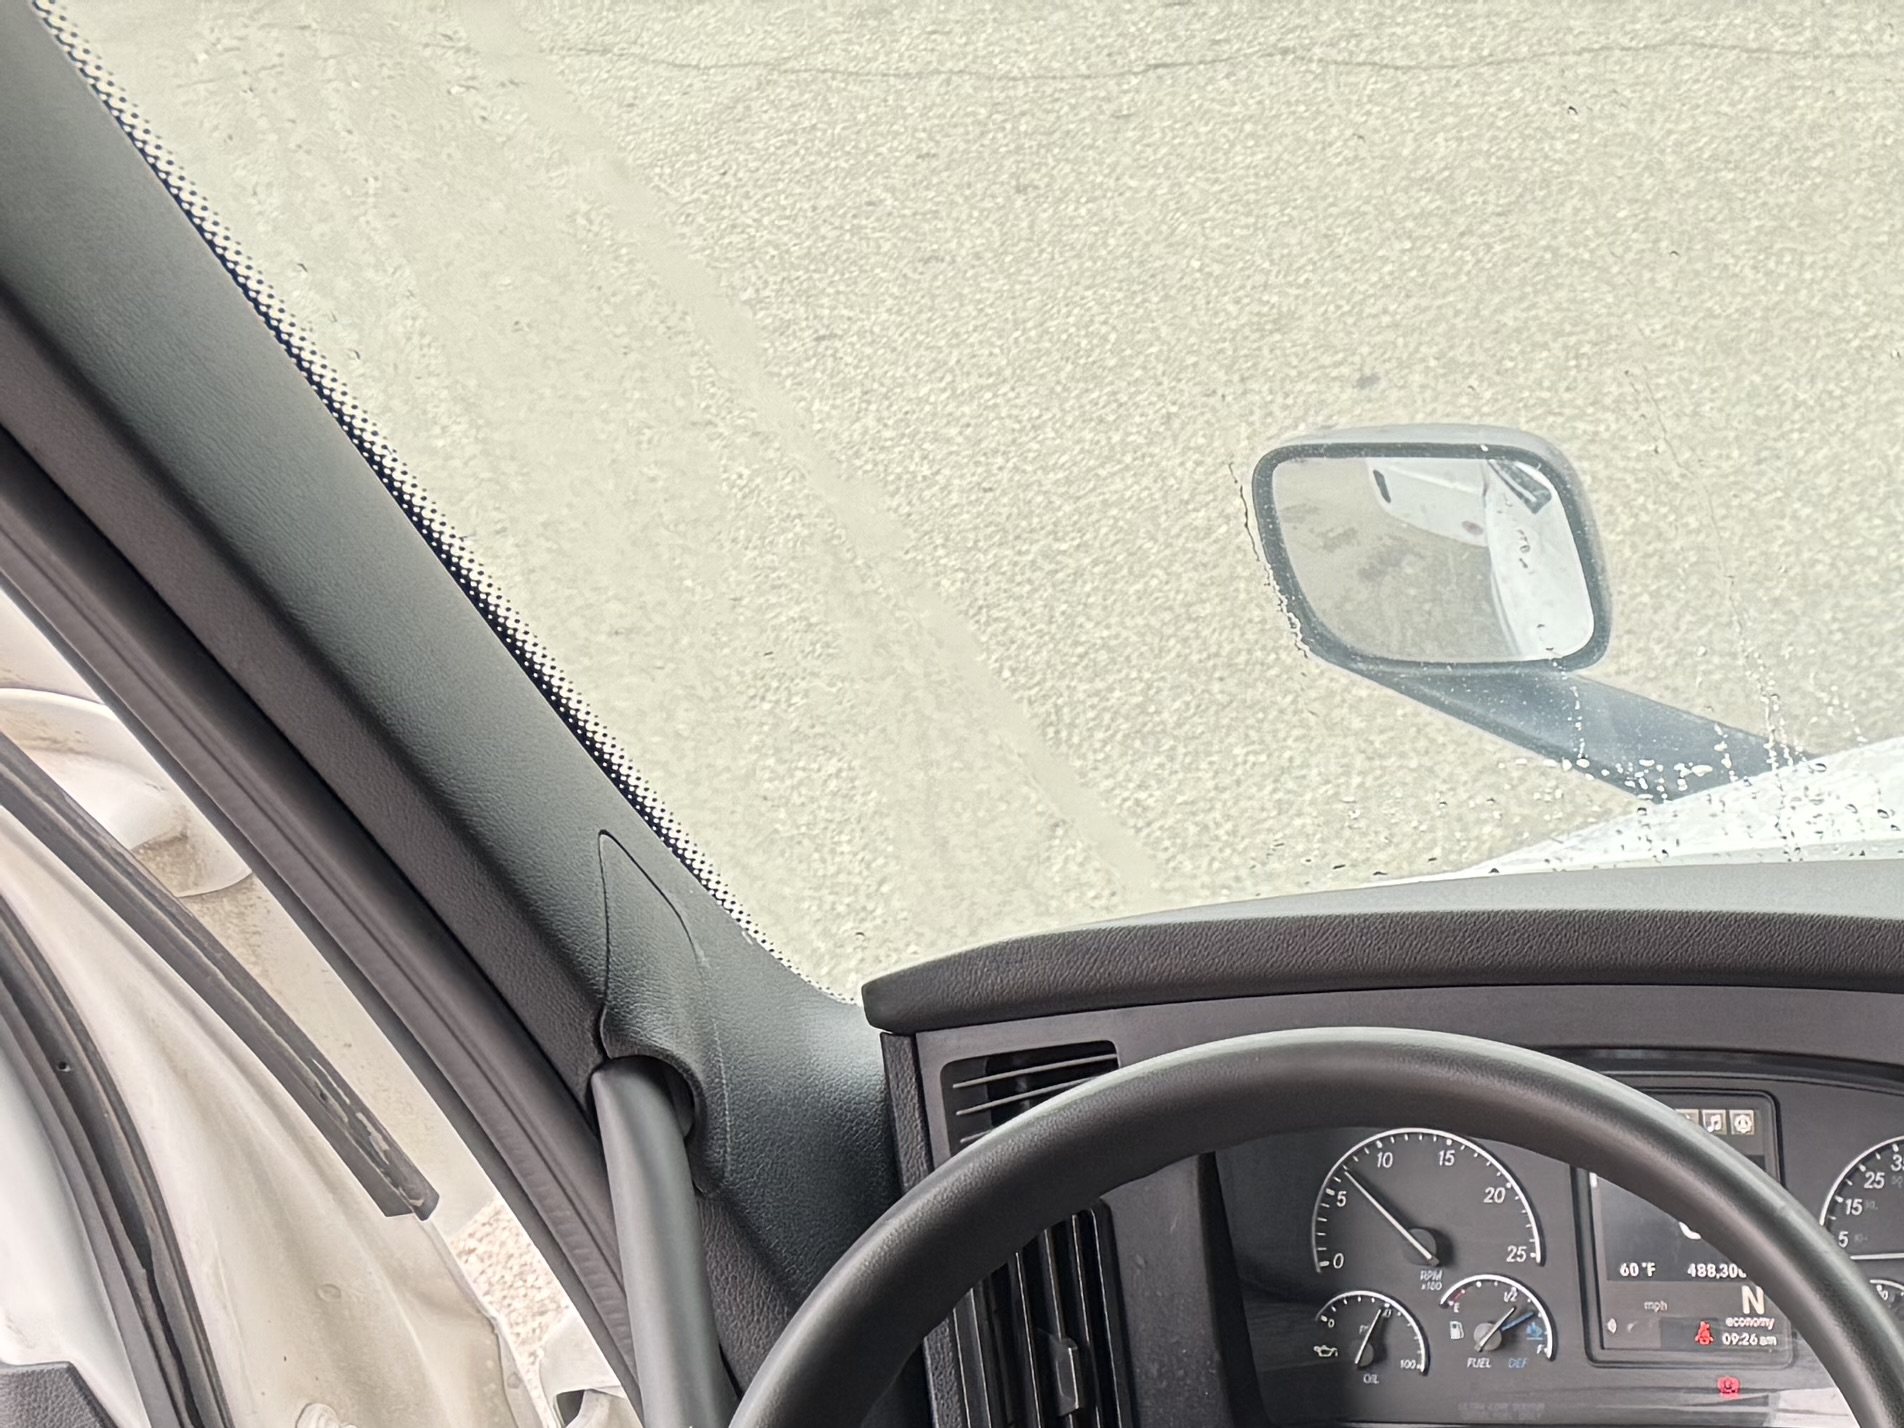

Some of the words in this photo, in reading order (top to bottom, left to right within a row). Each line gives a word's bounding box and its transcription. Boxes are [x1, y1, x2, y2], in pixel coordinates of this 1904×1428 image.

[1377, 1152, 1394, 1168] 10
[1439, 1150, 1455, 1166] 15
[1864, 1172, 1885, 1188] 25
[1336, 1191, 1347, 1207] 5
[1484, 1188, 1506, 1203] 20
[1845, 1199, 1863, 1215] 15
[1838, 1231, 1848, 1248] 5
[1333, 1253, 1345, 1269] 0
[1506, 1246, 1527, 1262] 25
[1620, 1262, 1639, 1277] 60
[1644, 1301, 1667, 1312] mph
[1741, 1285, 1765, 1314] N
[1726, 1318, 1775, 1330] economy
[1722, 1333, 1757, 1345] 09:26
[1759, 1335, 1777, 1345] am
[1400, 1360, 1416, 1369] 100
[1467, 1357, 1492, 1368] FUEL
[1363, 1373, 1379, 1384] OIL
